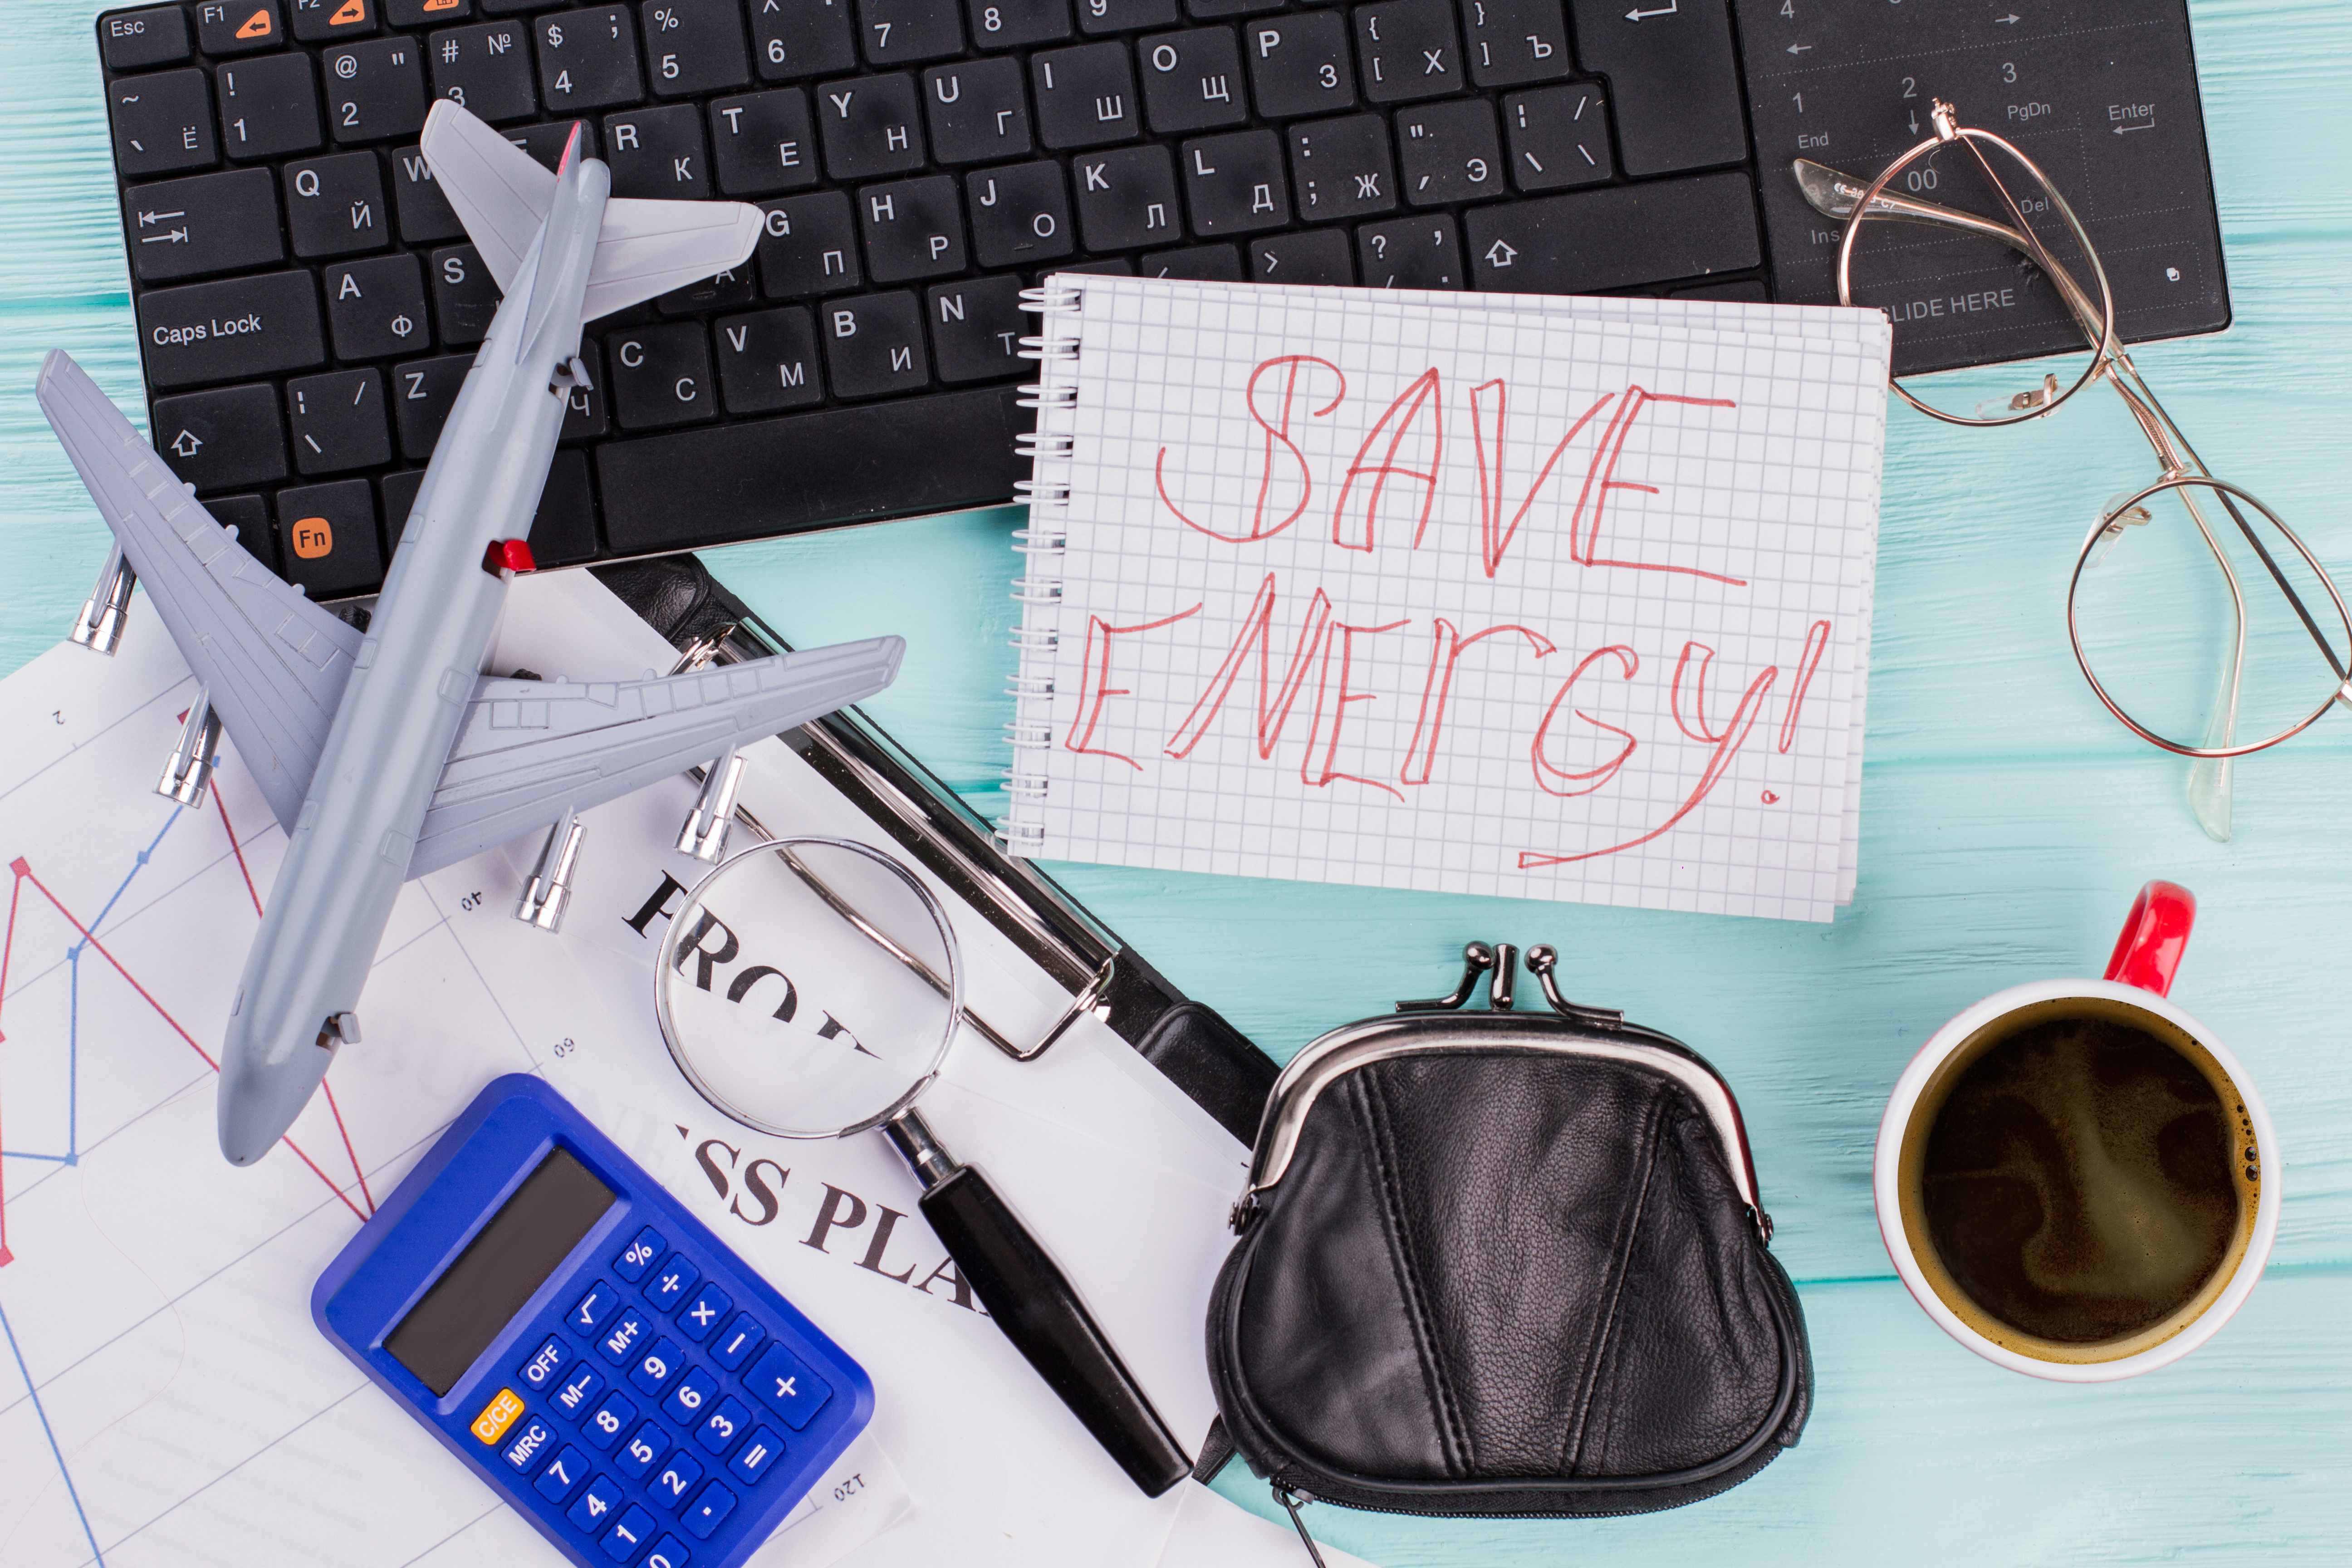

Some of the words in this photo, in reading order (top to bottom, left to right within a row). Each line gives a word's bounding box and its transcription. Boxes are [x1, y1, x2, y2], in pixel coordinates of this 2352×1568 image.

[204, 6, 224, 24] F1
[655, 8, 679, 31] %
[985, 7, 1001, 31] 8
[1780, 0, 1795, 19] 4
[111, 20, 144, 37] Esc
[548, 24, 563, 48] $
[874, 23, 891, 47] 7
[442, 39, 459, 63] #
[768, 39, 785, 63] 6
[1259, 30, 1280, 57] P
[335, 55, 357, 78] @
[662, 54, 679, 78] 5
[1152, 45, 1177, 71] O
[555, 70, 572, 93] 4
[2002, 62, 2017, 83] 3
[936, 76, 959, 103] U
[1902, 77, 1917, 98] 2
[342, 102, 359, 126] 2
[830, 92, 852, 118] Y
[1793, 92, 1803, 113] 1
[2007, 102, 2051, 121] PgDn
[2108, 103, 2155, 121] Enter
[234, 118, 246, 142] 1
[722, 108, 743, 133] T
[615, 124, 639, 151] R
[1798, 132, 1829, 149] End
[1195, 150, 1215, 175] L
[295, 170, 320, 196] Q
[1085, 163, 1109, 191] K
[980, 179, 996, 206] J
[871, 195, 894, 222] H
[2021, 196, 2049, 214] Del
[766, 210, 790, 237] G
[1372, 235, 1386, 259] ?
[1812, 228, 1840, 245] Ins
[444, 257, 465, 284] S
[339, 274, 362, 300] A
[940, 294, 964, 322] N
[1950, 289, 2015, 314] HERE
[153, 325, 206, 346] Caps
[211, 314, 261, 337] Lock
[833, 311, 856, 337] B
[726, 325, 747, 352] V
[620, 341, 643, 367] C
[405, 372, 426, 399] Z
[1156, 355, 1747, 587] SAVE
[299, 529, 326, 549] Fn
[462, 892, 481, 911] 40
[555, 1038, 574, 1058] 60
[799, 1182, 991, 1318] PLA
[608, 1322, 638, 1354] M+
[527, 1344, 559, 1382] OFF
[644, 1356, 666, 1379] 9
[679, 1386, 701, 1408] 6
[478, 1395, 518, 1437] C/CE
[596, 1410, 619, 1433] 8
[710, 1415, 733, 1437] 3
[508, 1424, 546, 1467] MRC
[630, 1439, 652, 1463] 5
[549, 1460, 570, 1485] 7
[662, 1470, 687, 1495] 2
[834, 1474, 864, 1501] 120
[588, 1494, 607, 1517] 4
[617, 1524, 637, 1544] 1
